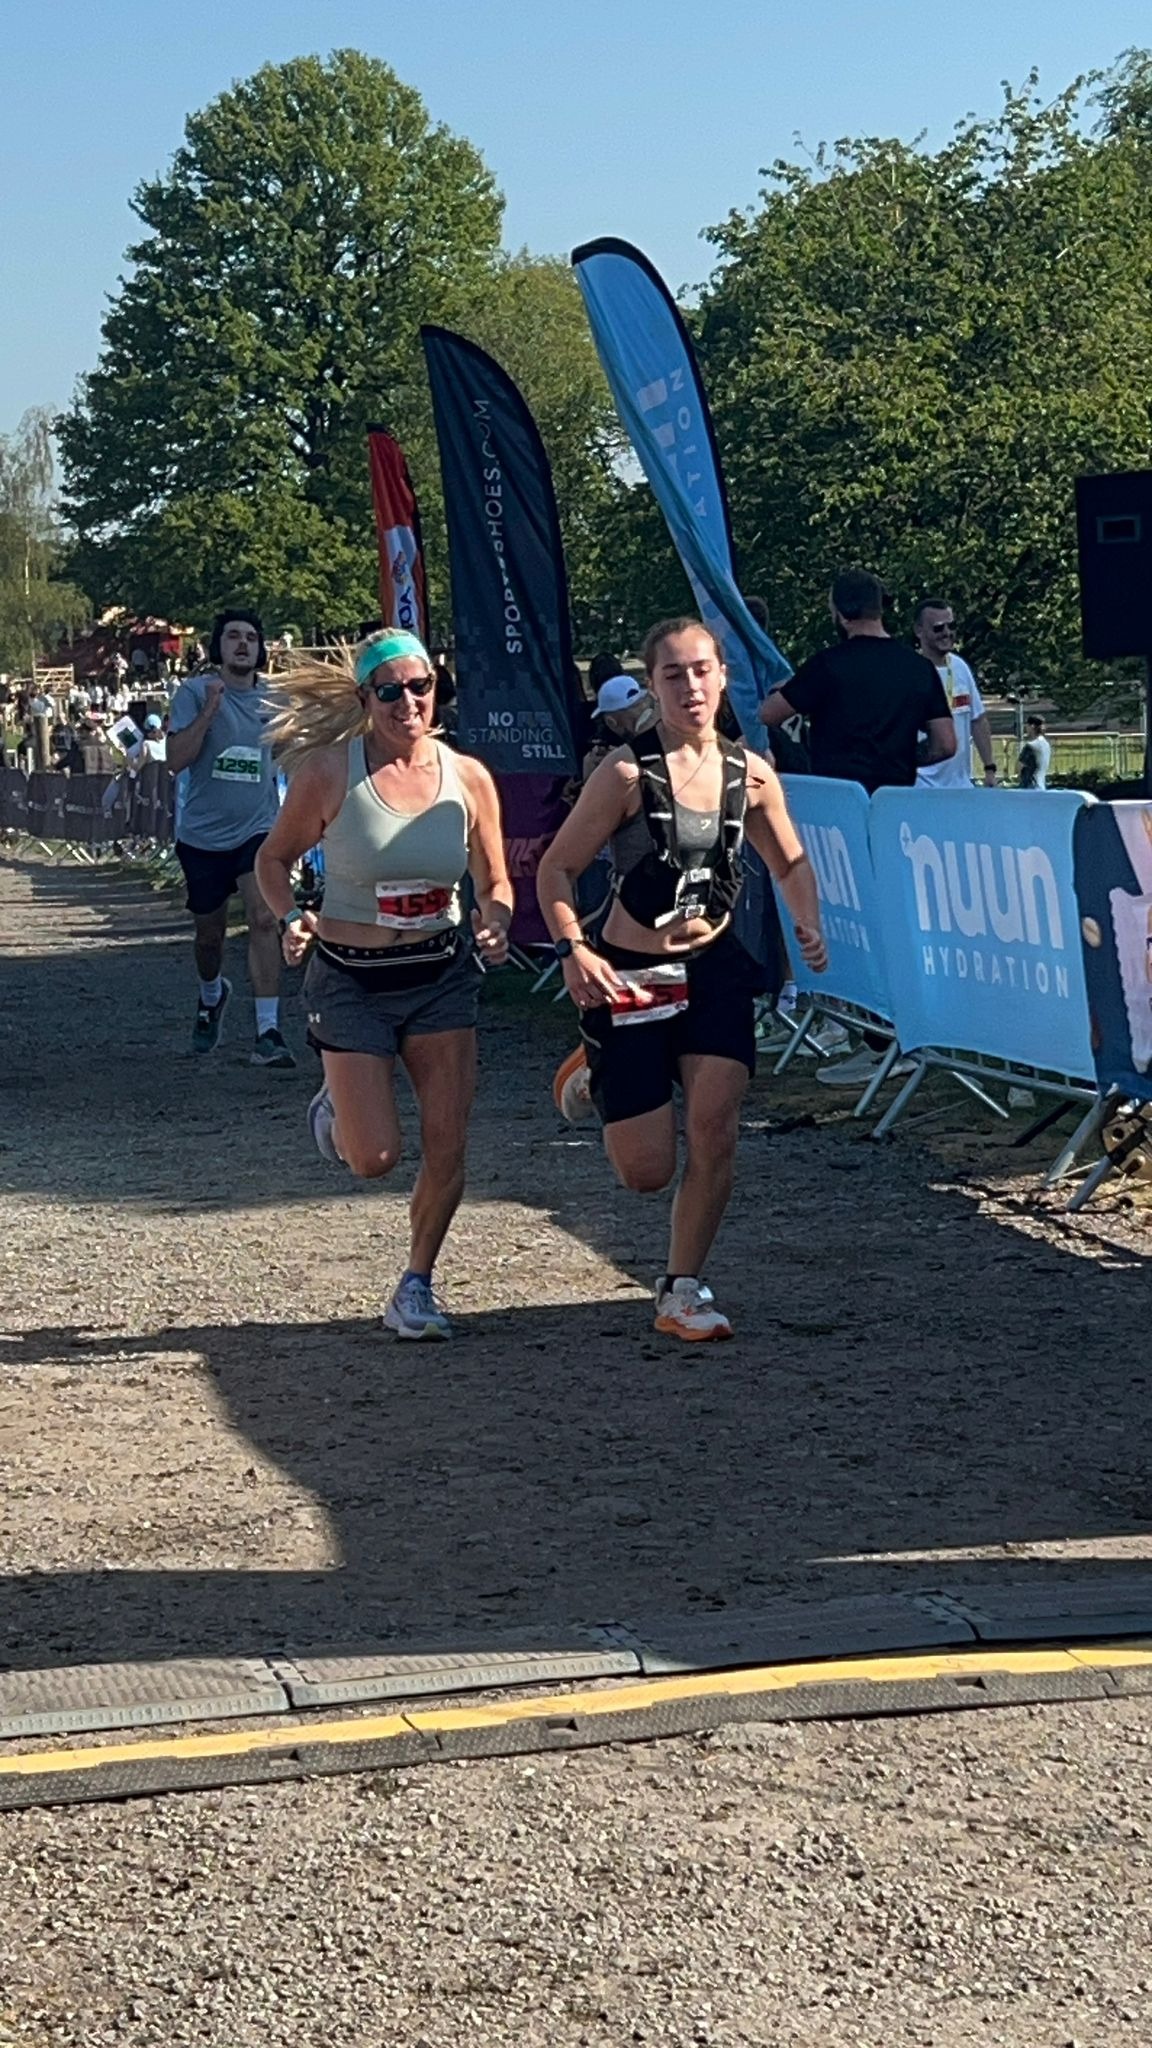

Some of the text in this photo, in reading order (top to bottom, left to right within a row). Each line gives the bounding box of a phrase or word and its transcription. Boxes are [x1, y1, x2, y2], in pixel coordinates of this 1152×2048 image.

[488, 711, 514, 726] NO
[468, 727, 552, 743] STANDING
[521, 744, 565, 758] STILL
[900, 821, 1064, 949] nuun
[922, 945, 1069, 998] HYDRATION
